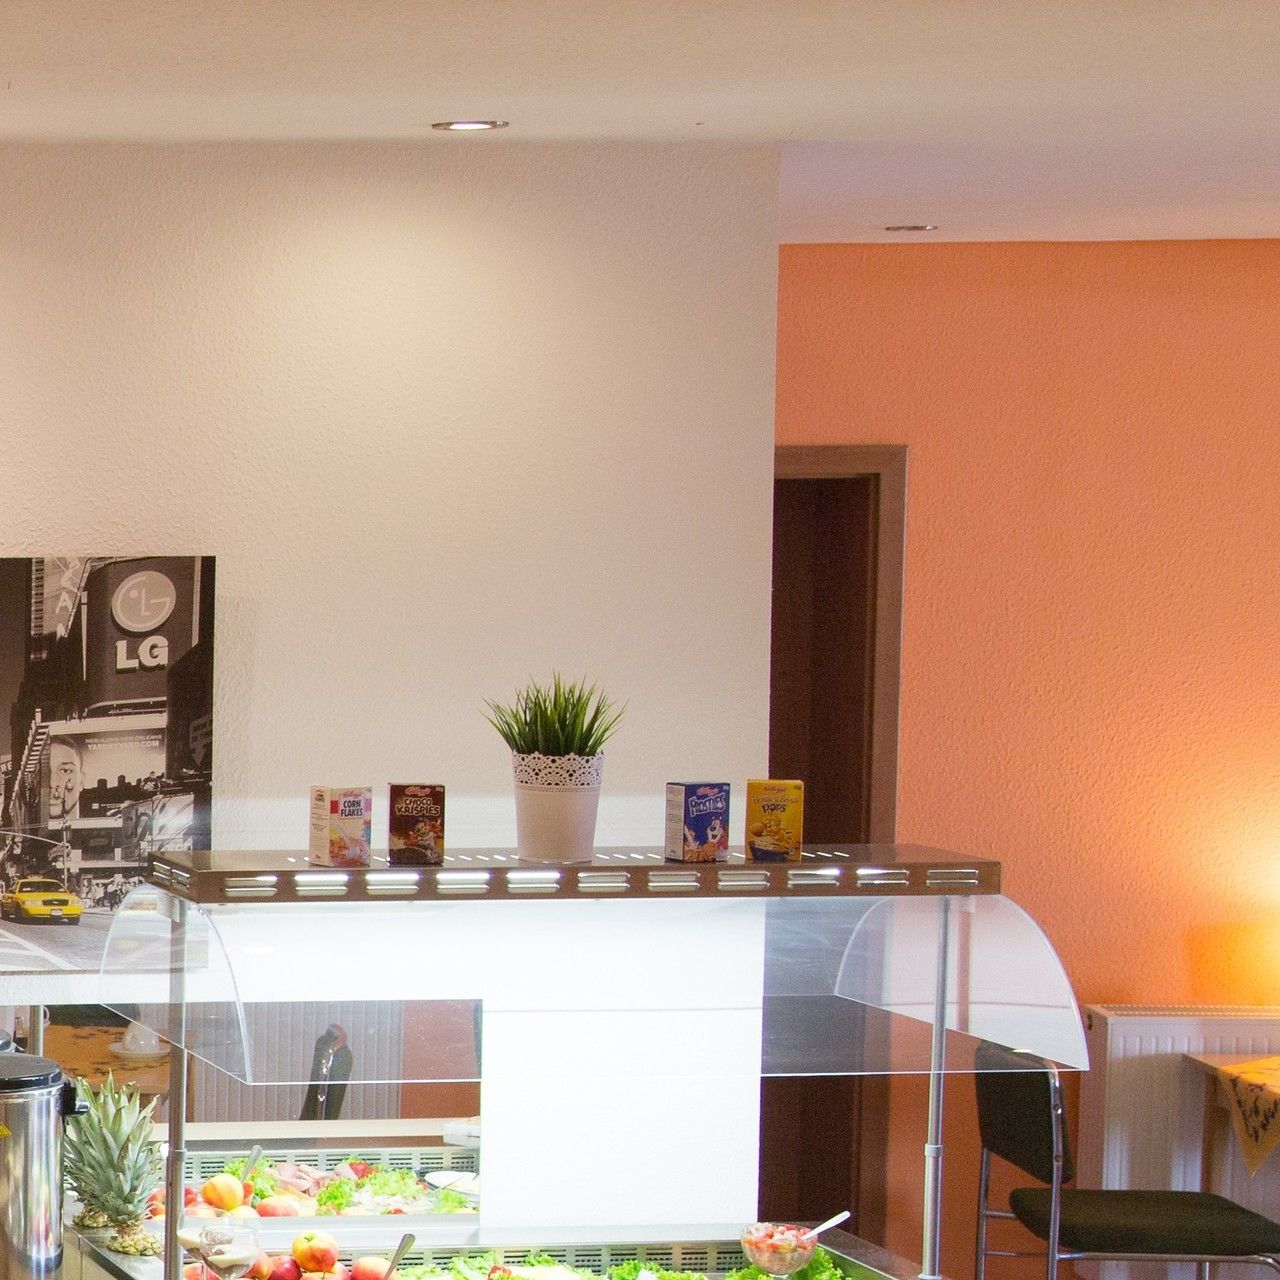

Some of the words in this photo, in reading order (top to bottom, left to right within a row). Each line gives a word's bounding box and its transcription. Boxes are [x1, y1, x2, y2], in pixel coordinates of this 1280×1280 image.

[116, 635, 169, 669] LG
[343, 800, 361, 809] CORN
[404, 797, 433, 806] CHOCO
[341, 808, 363, 818] FLAKES
[396, 805, 440, 816] KRISPIES
